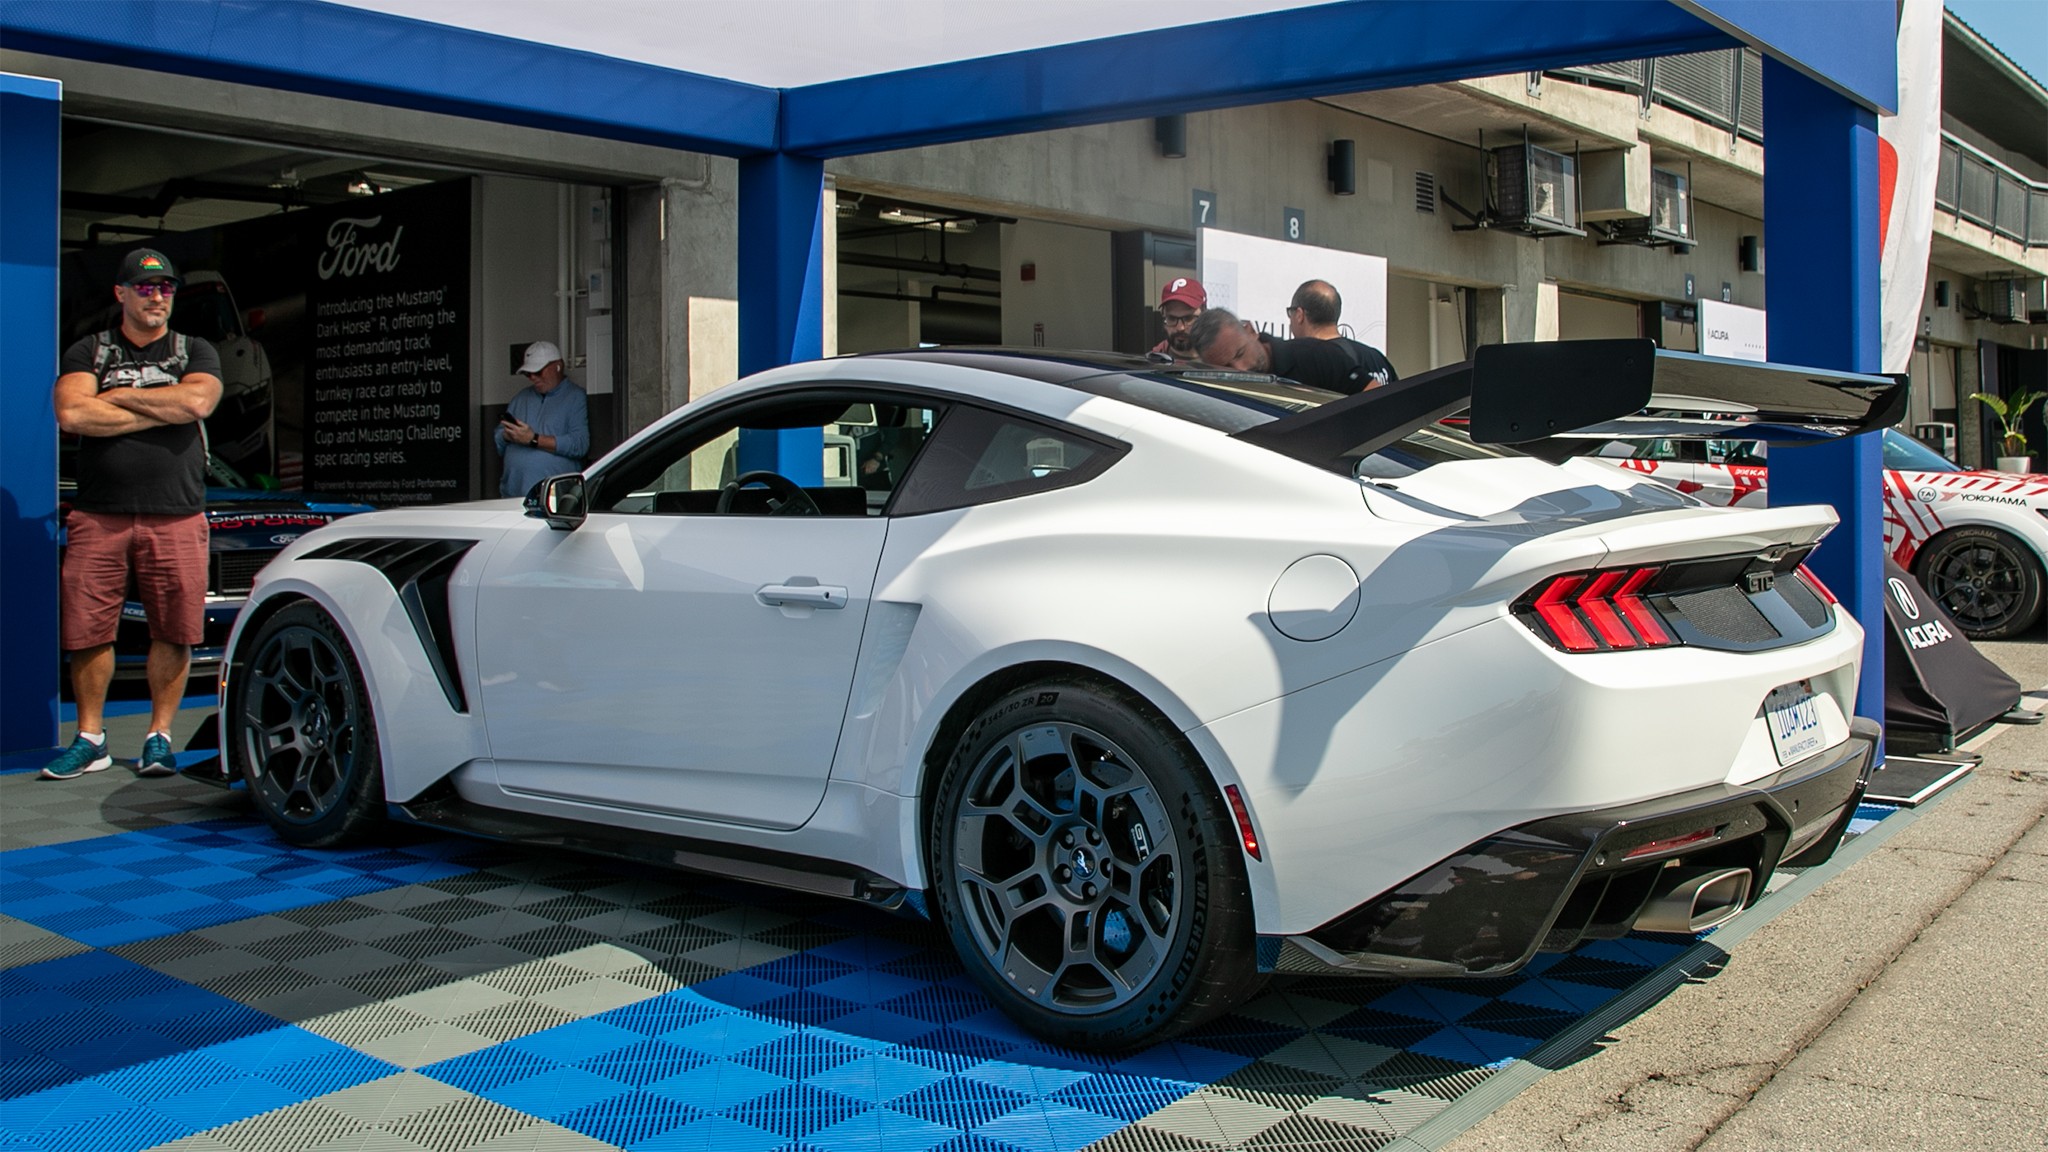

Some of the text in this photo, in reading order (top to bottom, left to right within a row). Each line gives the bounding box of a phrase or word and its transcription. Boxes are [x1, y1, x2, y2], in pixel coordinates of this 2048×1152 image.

[1199, 200, 1210, 223] 7
[1290, 217, 1299, 239] 8
[318, 214, 404, 280] Ford
[1687, 280, 1693, 295] 9
[317, 296, 373, 316] Introducing
[376, 294, 394, 310] the
[317, 321, 339, 338] Dark
[380, 316, 390, 332] R,
[392, 312, 434, 329] offering
[437, 309, 456, 325] the
[316, 333, 431, 359] most demanding track
[315, 354, 452, 380] enthusiasts an entry-level,
[315, 379, 442, 402] turnkey race car ready to
[315, 403, 440, 424] compete in the Mustang
[315, 423, 462, 447] Cup and Mustang Challenge
[314, 448, 406, 468] spec racing series.
[401, 478, 416, 488] Ford
[417, 477, 457, 488] Performance
[1960, 493, 2028, 507] YOKOHAMA
[209, 513, 324, 524] OMPETITION
[1904, 619, 1953, 650] ACURA
[986, 694, 1055, 726] 345/30 ZR 20
[1774, 695, 1818, 740] 104M123
[1134, 823, 1150, 861] GT
[1174, 880, 1208, 988] MICHELIN
